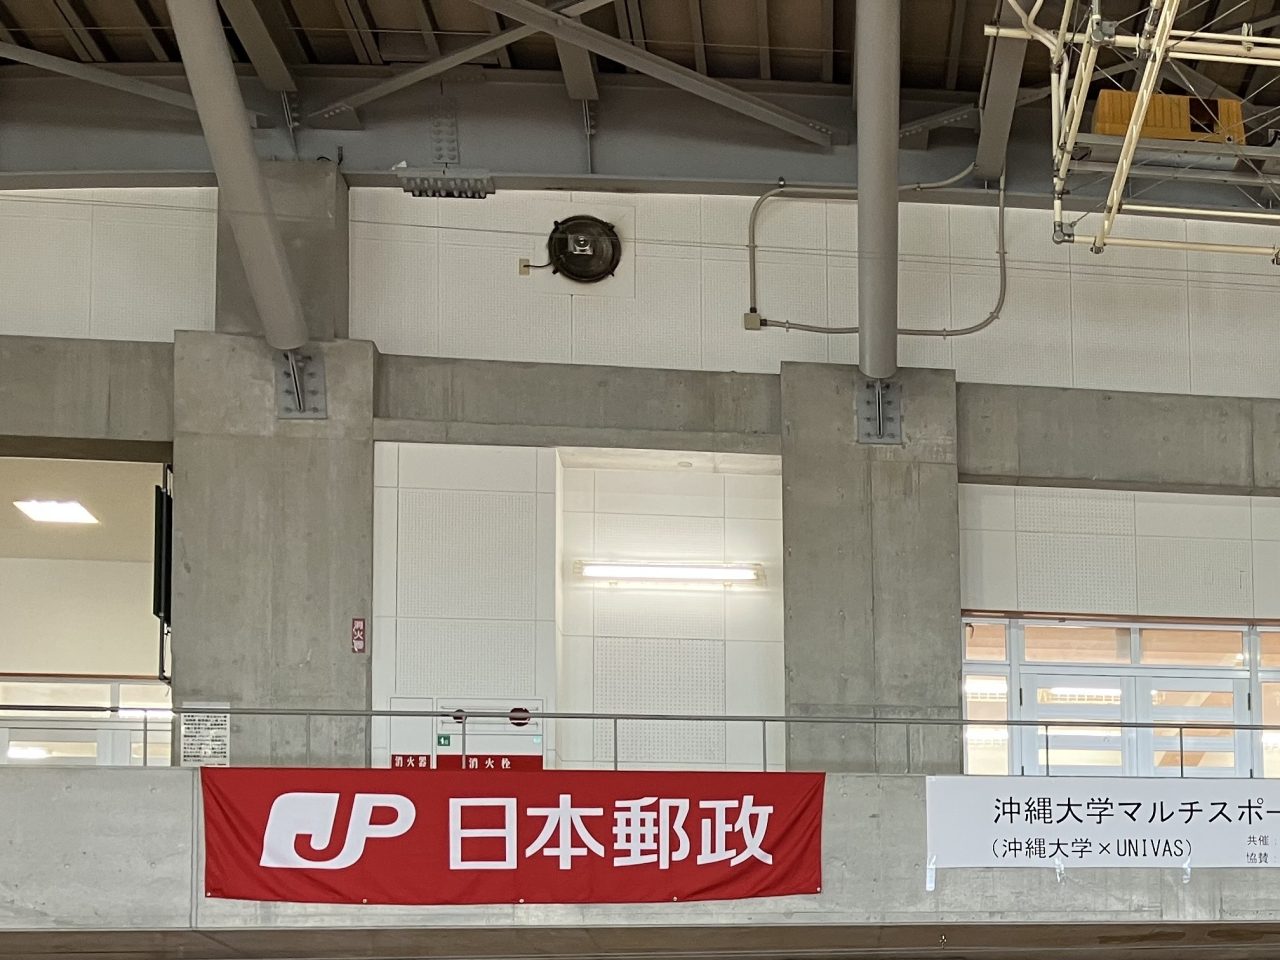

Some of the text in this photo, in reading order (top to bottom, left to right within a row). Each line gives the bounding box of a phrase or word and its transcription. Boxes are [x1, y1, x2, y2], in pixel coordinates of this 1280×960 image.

[394, 756, 427, 768] 消火器
[469, 757, 511, 769] 消火栓
[259, 792, 774, 870] JP 日本郵政
